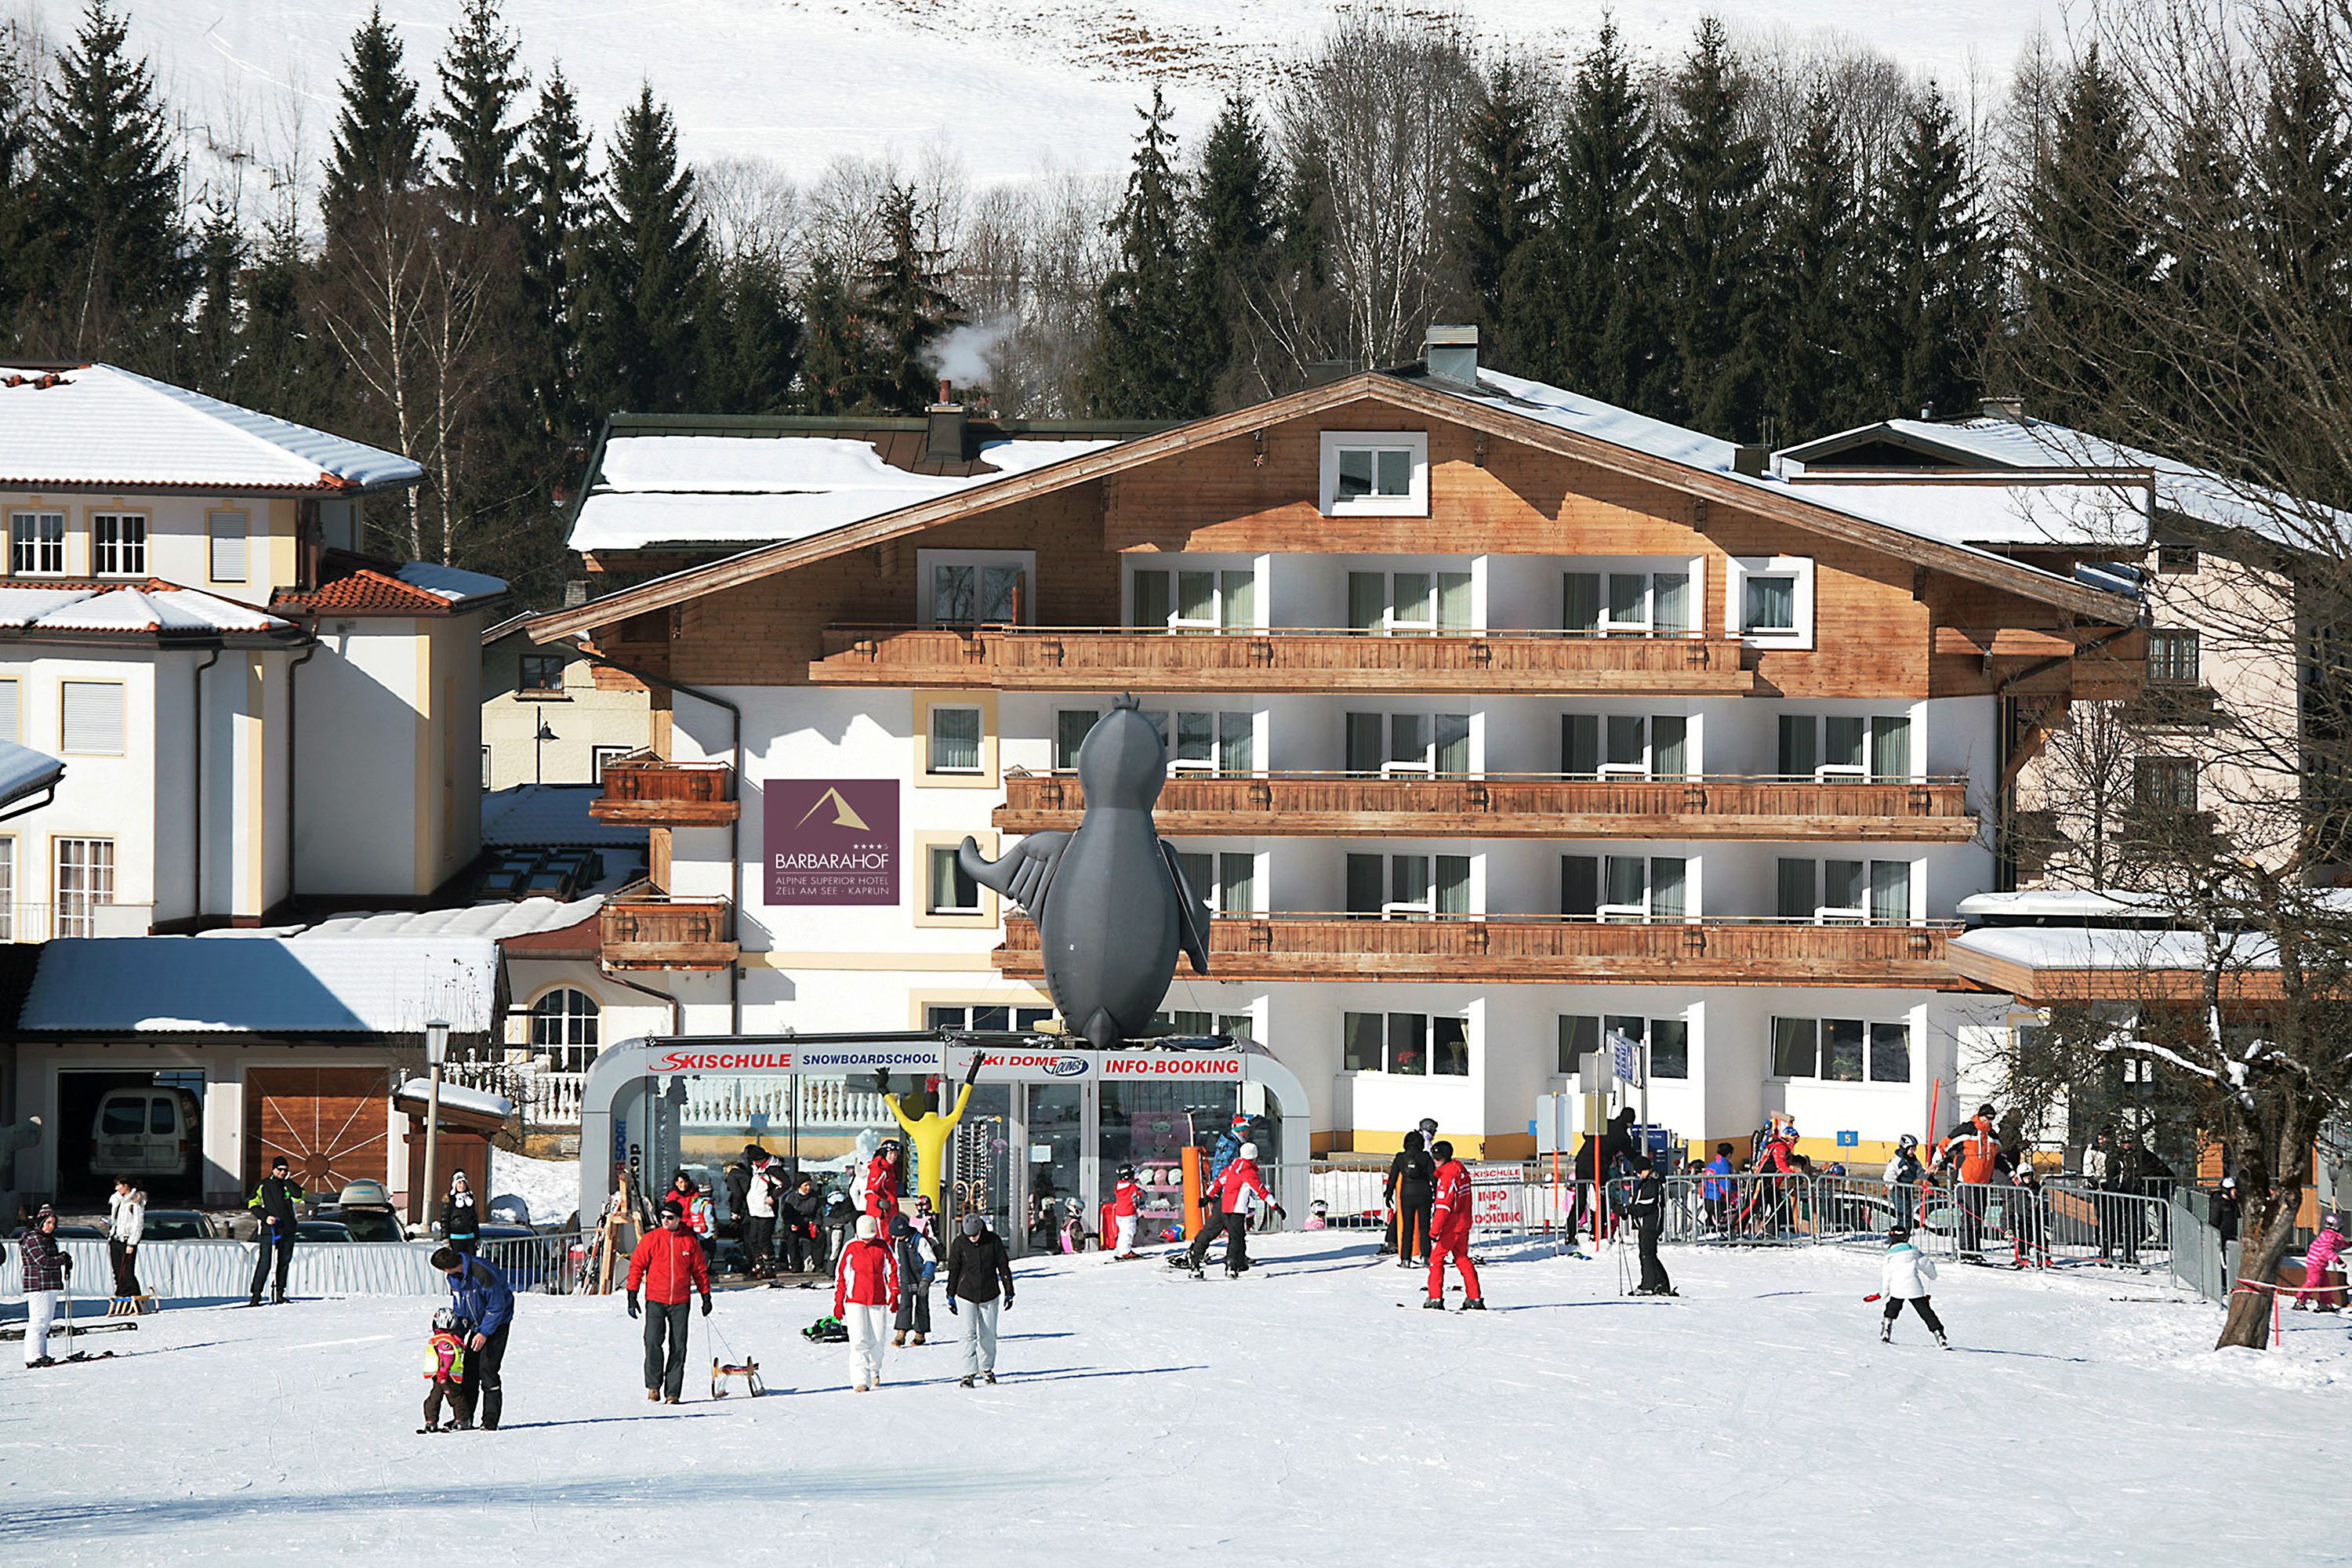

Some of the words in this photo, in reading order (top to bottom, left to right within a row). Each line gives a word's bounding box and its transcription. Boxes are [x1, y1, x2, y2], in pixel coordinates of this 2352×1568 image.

[775, 854, 888, 869] BARBARAHOF
[775, 877, 808, 885] ALPINE
[811, 877, 855, 885] SUPERIOR
[858, 877, 888, 885] HOTEL
[775, 887, 795, 895] ZELL
[800, 887, 817, 895] AM
[821, 887, 837, 895] SEE
[848, 887, 889, 895] KAPRUN
[649, 1051, 792, 1071] SKISCHULE
[802, 1053, 939, 1065] SNOWBOARDSCHOOL
[1009, 1056, 1061, 1066] DOME
[1051, 1059, 1084, 1075] LOUNGE
[1105, 1060, 1239, 1073] INFO-BOOKING
[1845, 1134, 1851, 1144] 5
[1479, 1190, 1507, 1202] INFO
